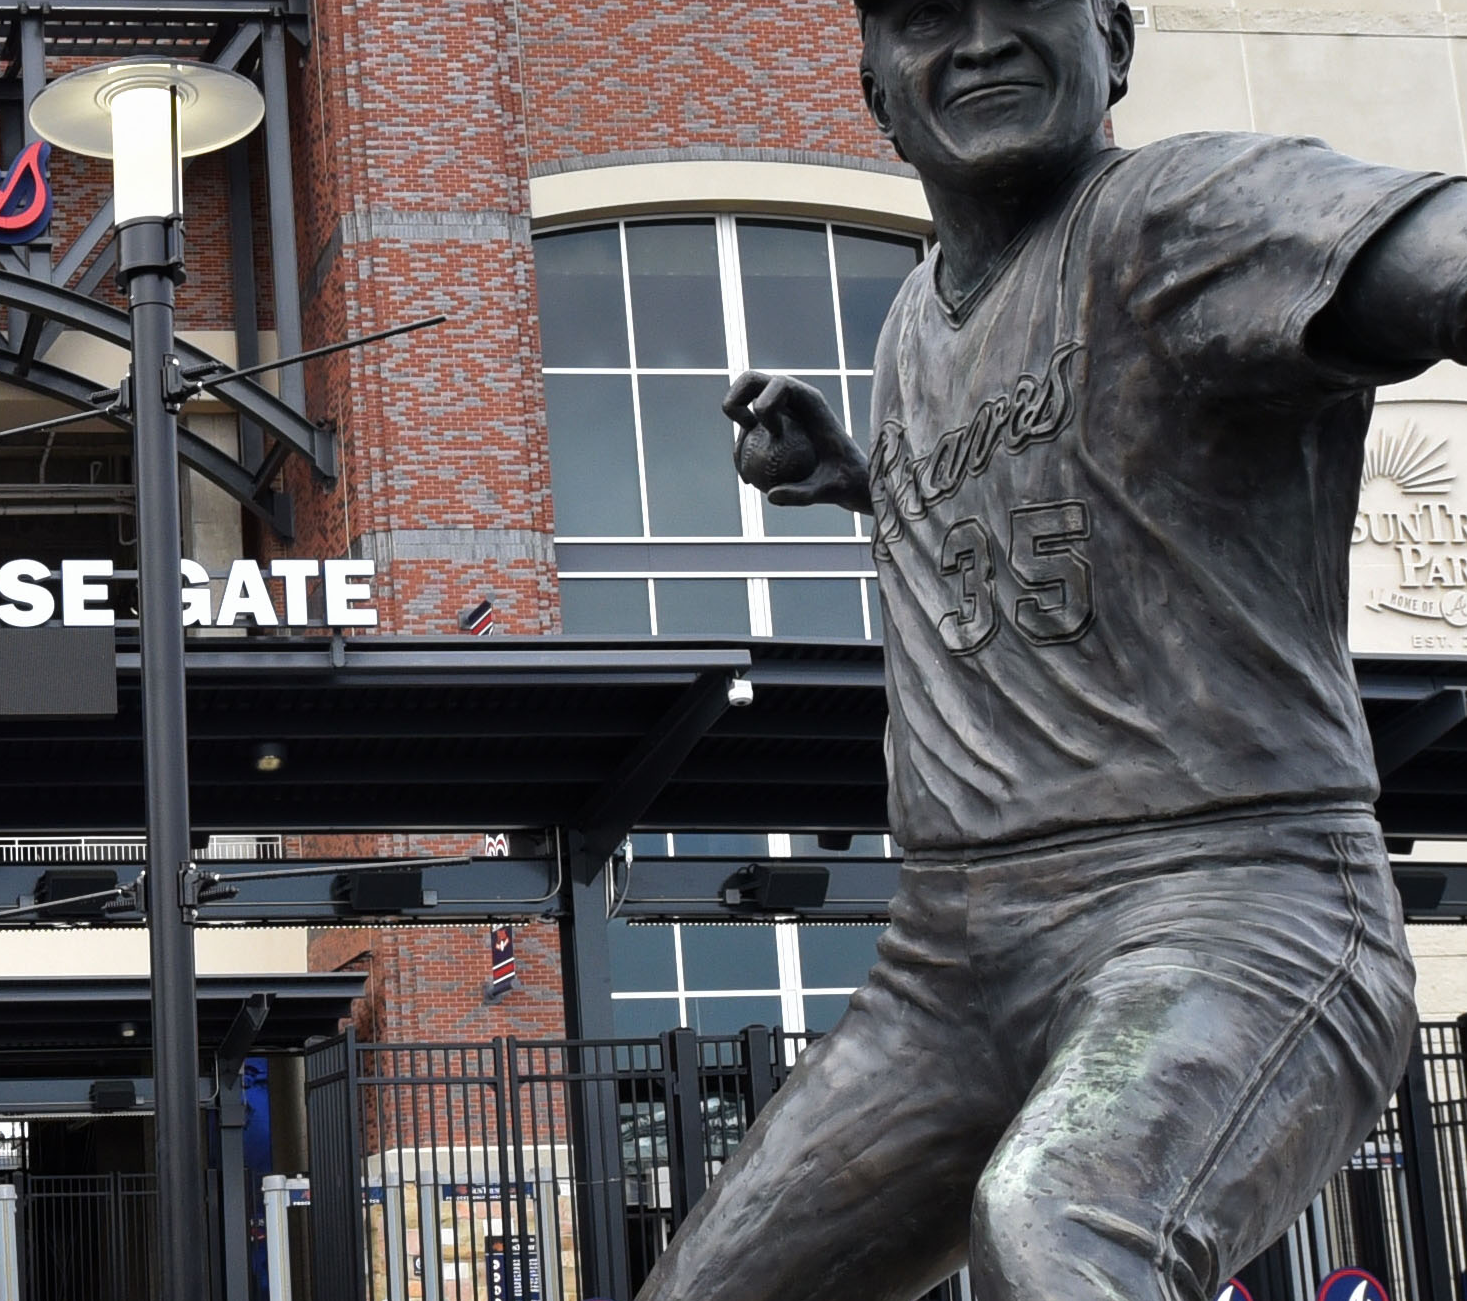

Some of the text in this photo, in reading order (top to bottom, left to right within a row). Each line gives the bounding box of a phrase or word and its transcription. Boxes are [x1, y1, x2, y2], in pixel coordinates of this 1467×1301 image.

[937, 499, 1096, 657] 35
[1391, 593, 1434, 613] HOME OF
